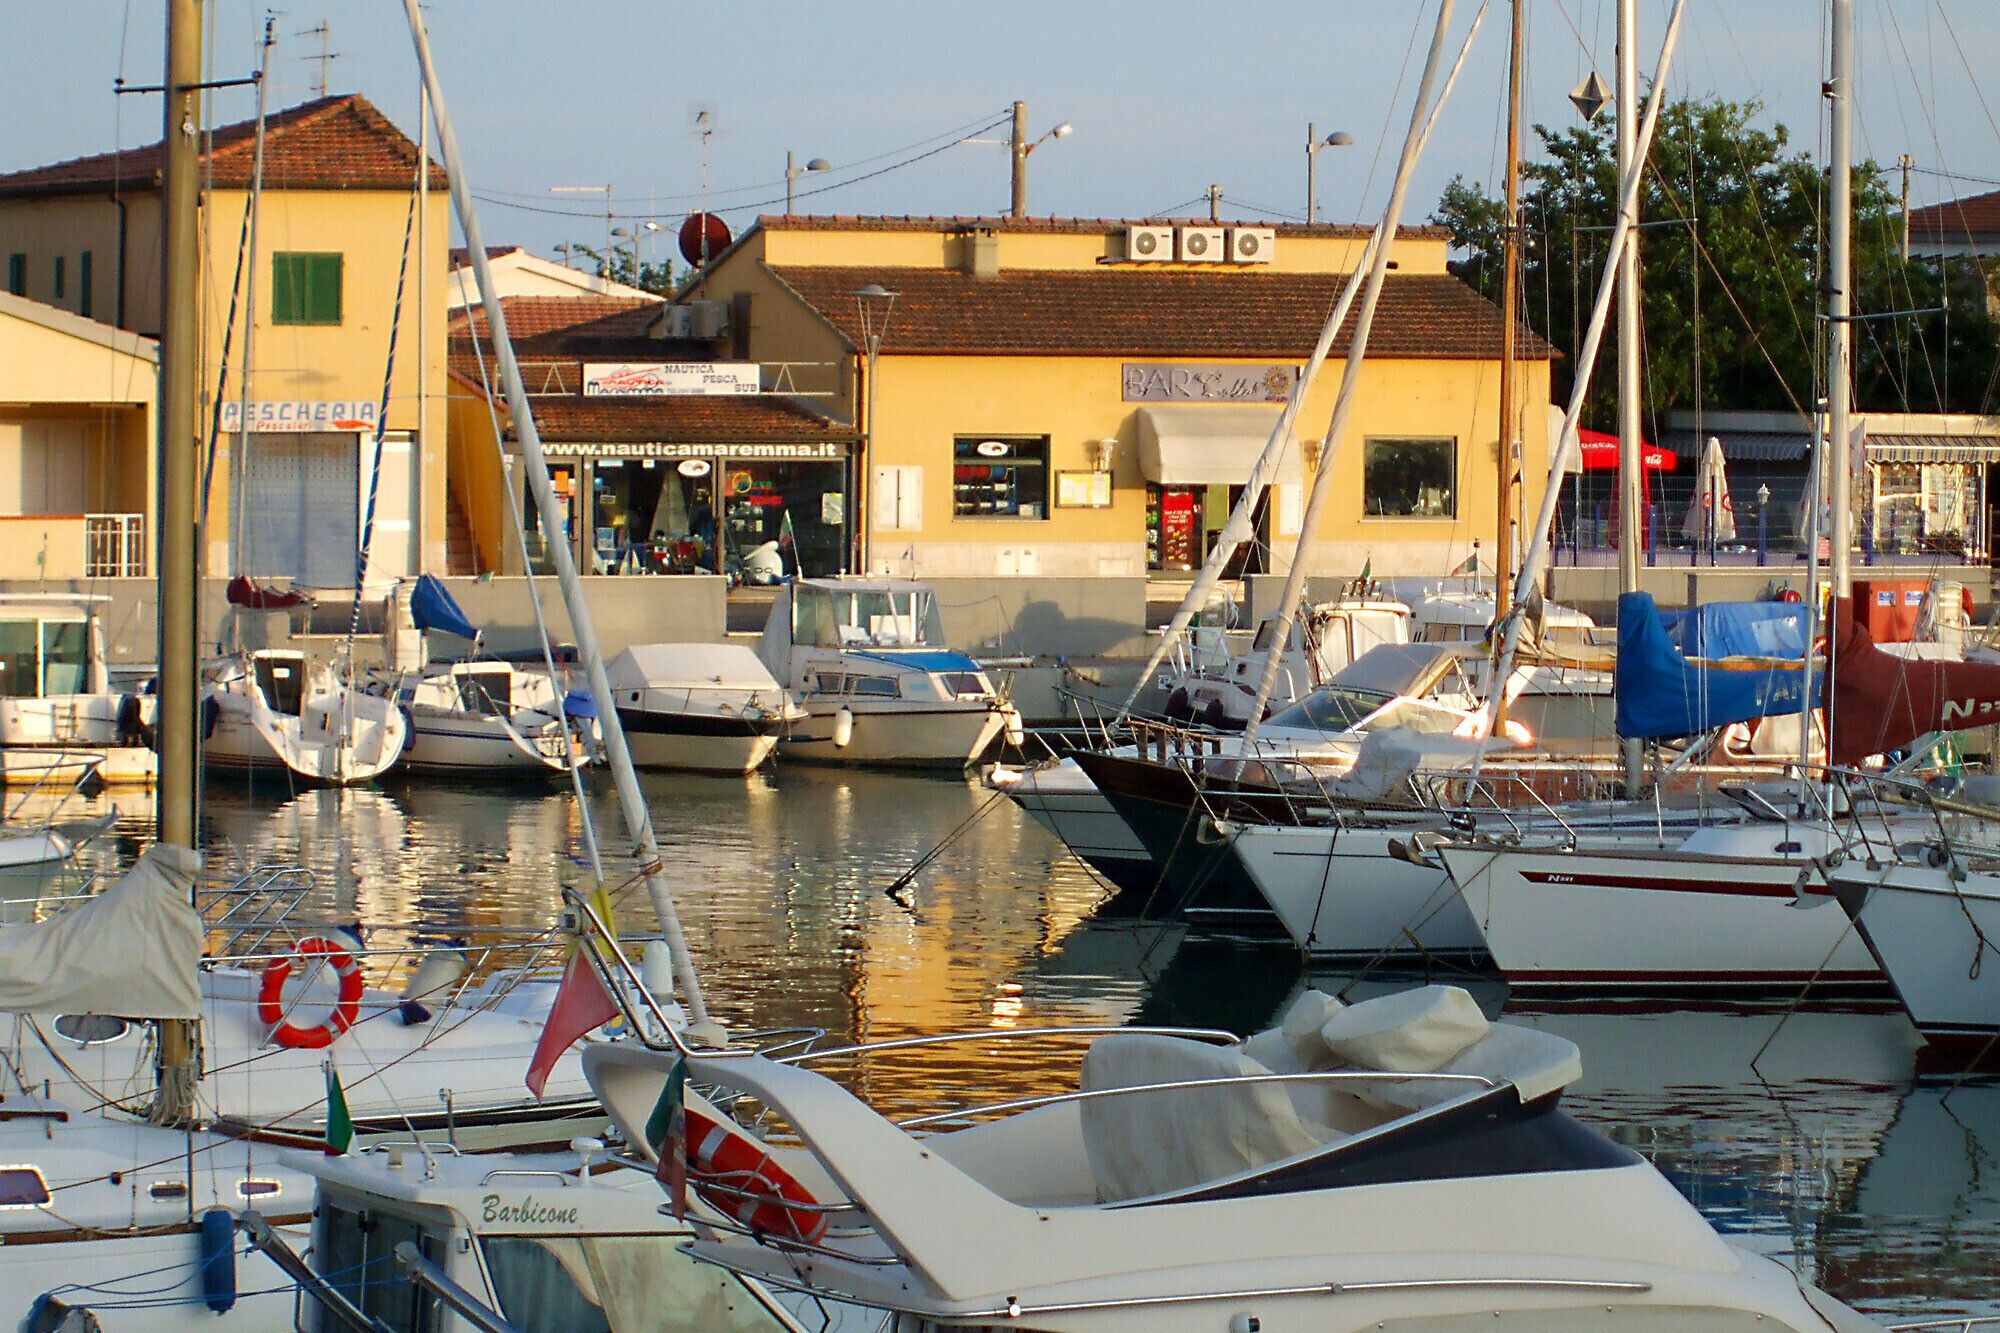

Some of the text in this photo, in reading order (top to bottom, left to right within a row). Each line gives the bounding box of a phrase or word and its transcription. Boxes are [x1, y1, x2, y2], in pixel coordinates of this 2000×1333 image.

[664, 364, 715, 374] NAUTICA
[702, 375, 739, 384] PESCA
[1126, 367, 1192, 398] BAR
[734, 383, 758, 393] SUB
[223, 402, 375, 421] PESCHERIA
[540, 442, 836, 457] www.nauticamaremma.it
[482, 1194, 577, 1223] Barbicone
